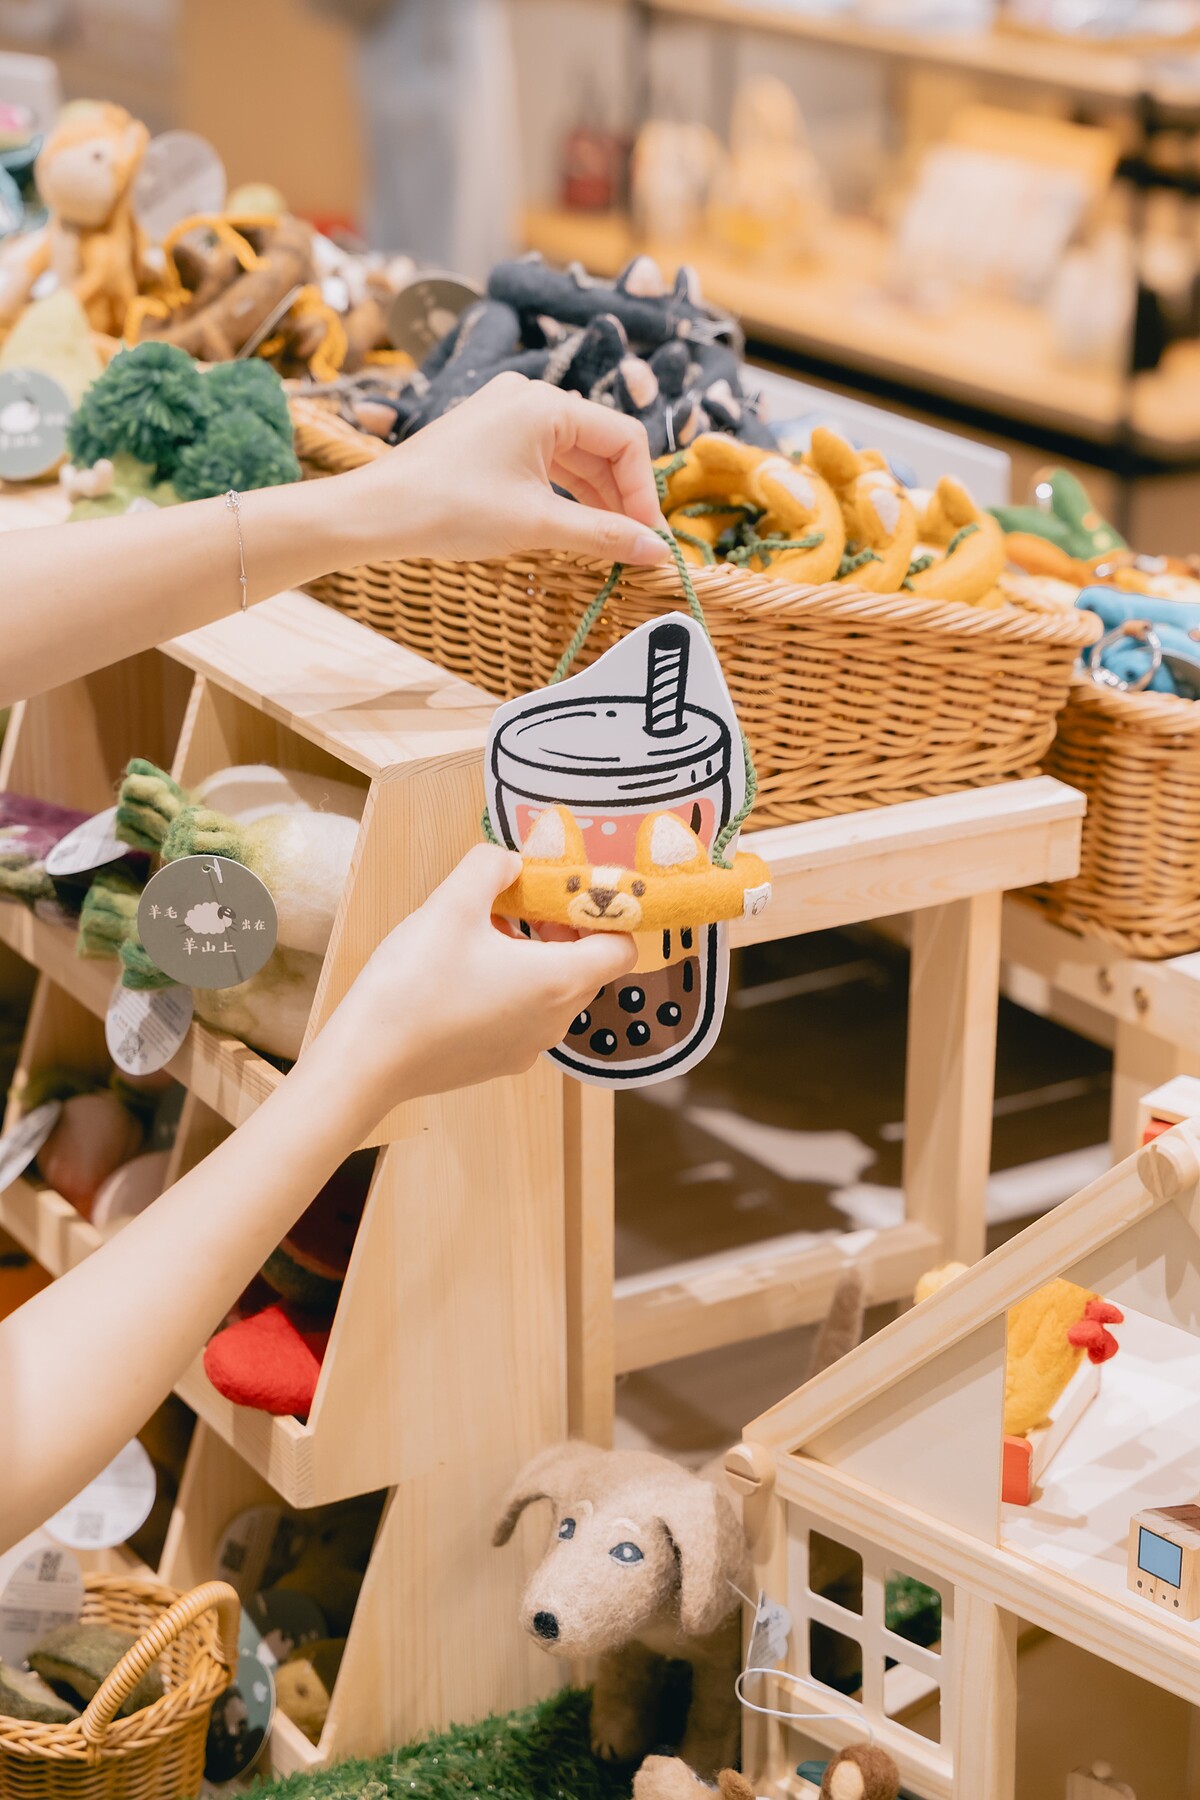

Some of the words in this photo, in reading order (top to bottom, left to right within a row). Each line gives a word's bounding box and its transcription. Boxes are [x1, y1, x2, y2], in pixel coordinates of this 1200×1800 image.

[148, 904, 178, 920] 羊毛
[242, 919, 266, 931] 出在
[182, 937, 237, 956] 羊山上
